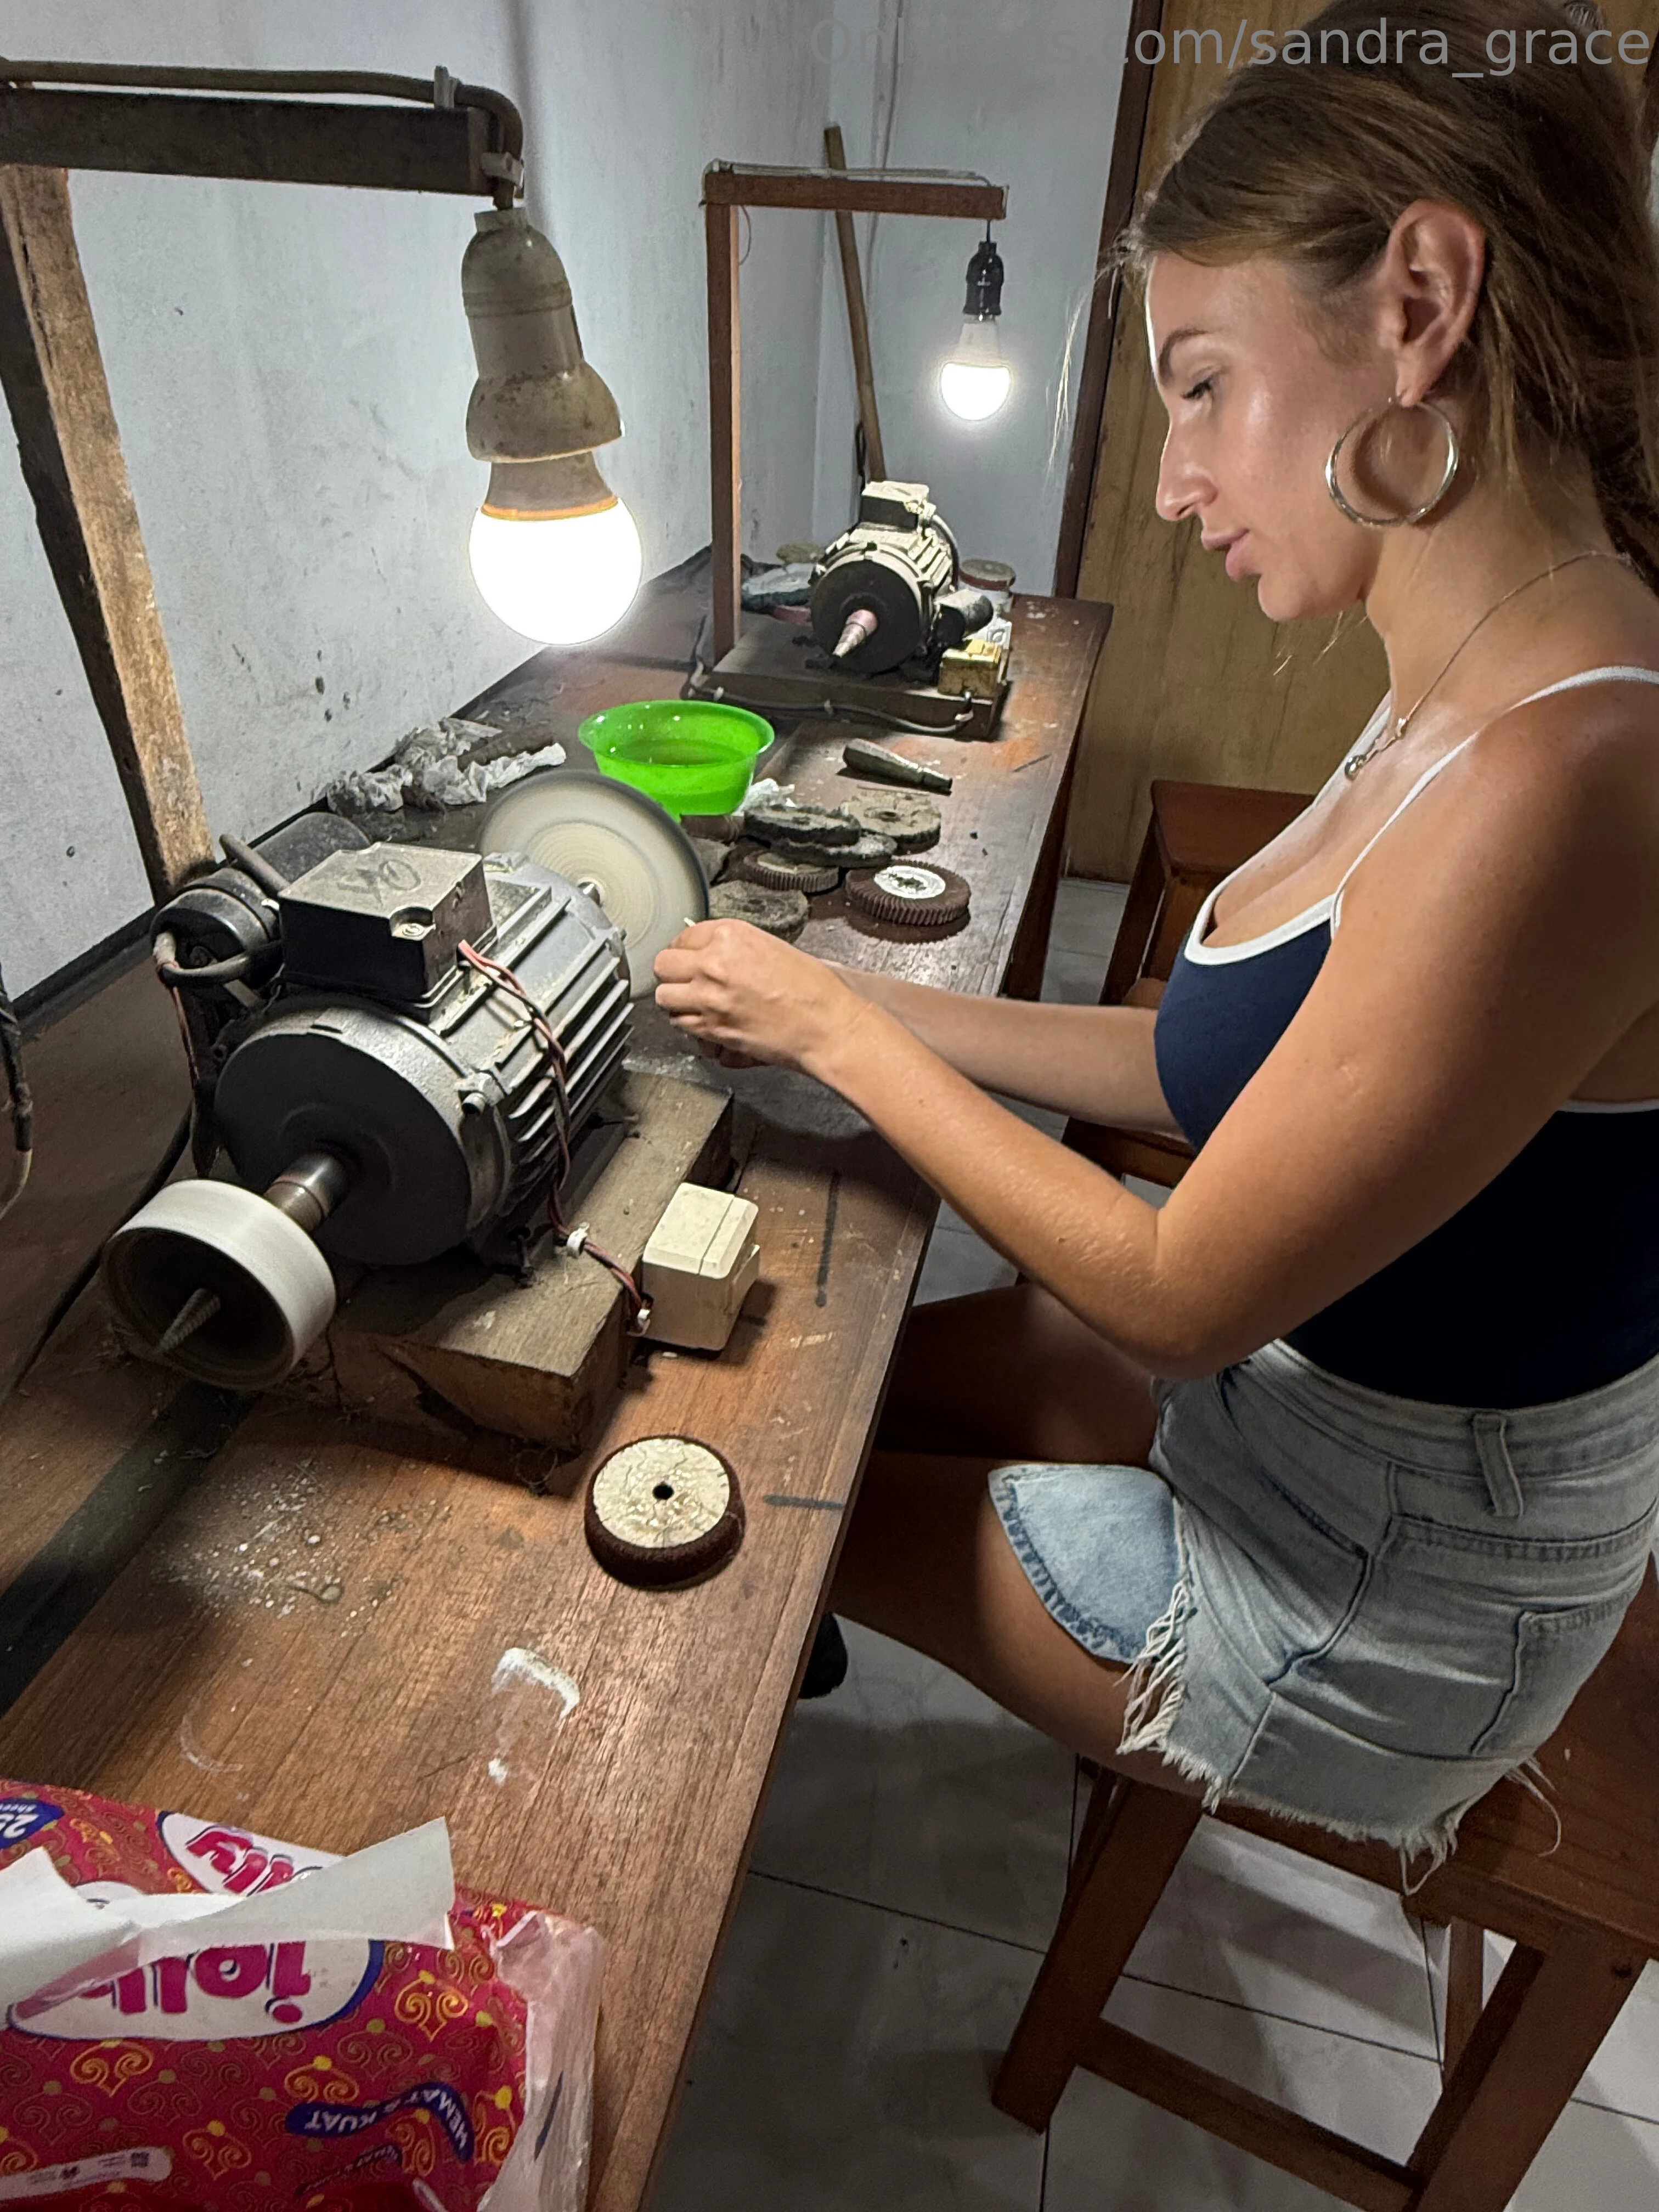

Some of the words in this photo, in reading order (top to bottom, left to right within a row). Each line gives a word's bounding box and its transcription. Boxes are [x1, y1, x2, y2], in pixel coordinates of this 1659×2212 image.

[78, 1942, 311, 2024] joll
[304, 2110, 377, 2131] KUAT
[404, 2089, 468, 2149] HEMAT
